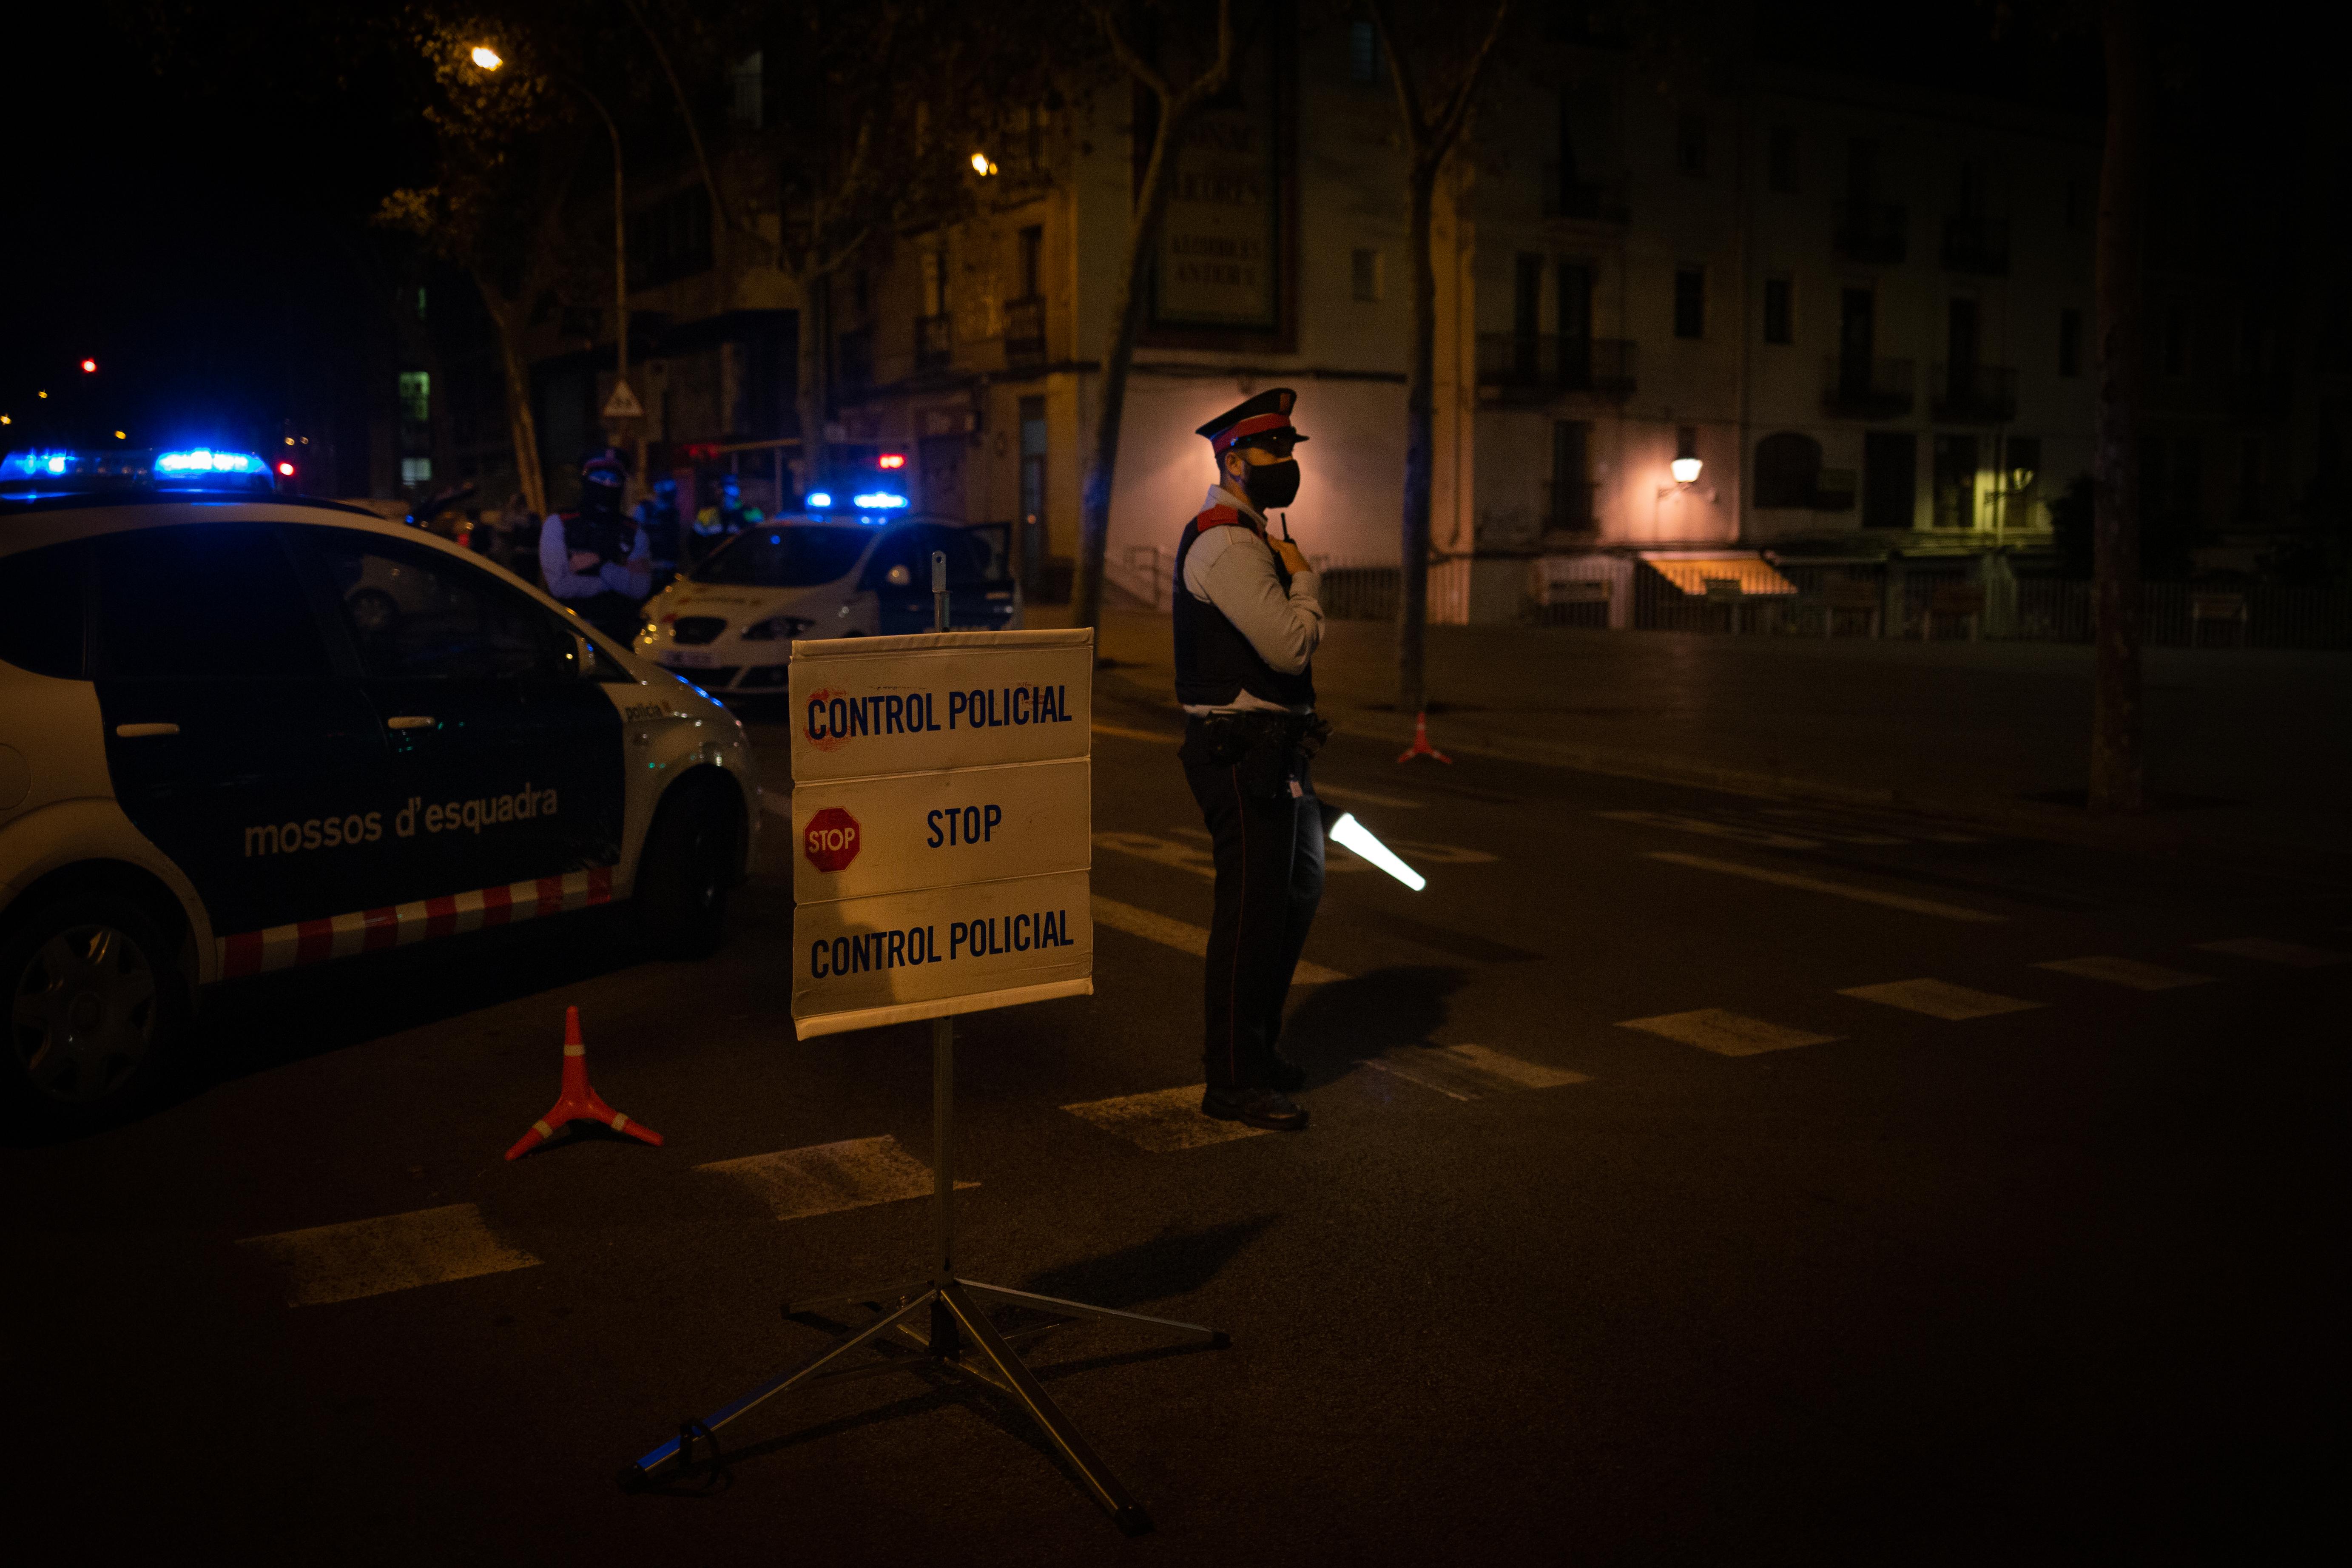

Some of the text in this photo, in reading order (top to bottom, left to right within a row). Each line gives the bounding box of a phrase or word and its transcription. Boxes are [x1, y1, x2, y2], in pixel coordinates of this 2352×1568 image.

[808, 685, 1072, 740] CONTROL POLICIAL
[245, 782, 558, 857] mossos d'esquadra
[808, 826, 856, 854] STOP
[927, 804, 1002, 848] STOP
[811, 910, 1074, 979] CONTROL POLICIAL
